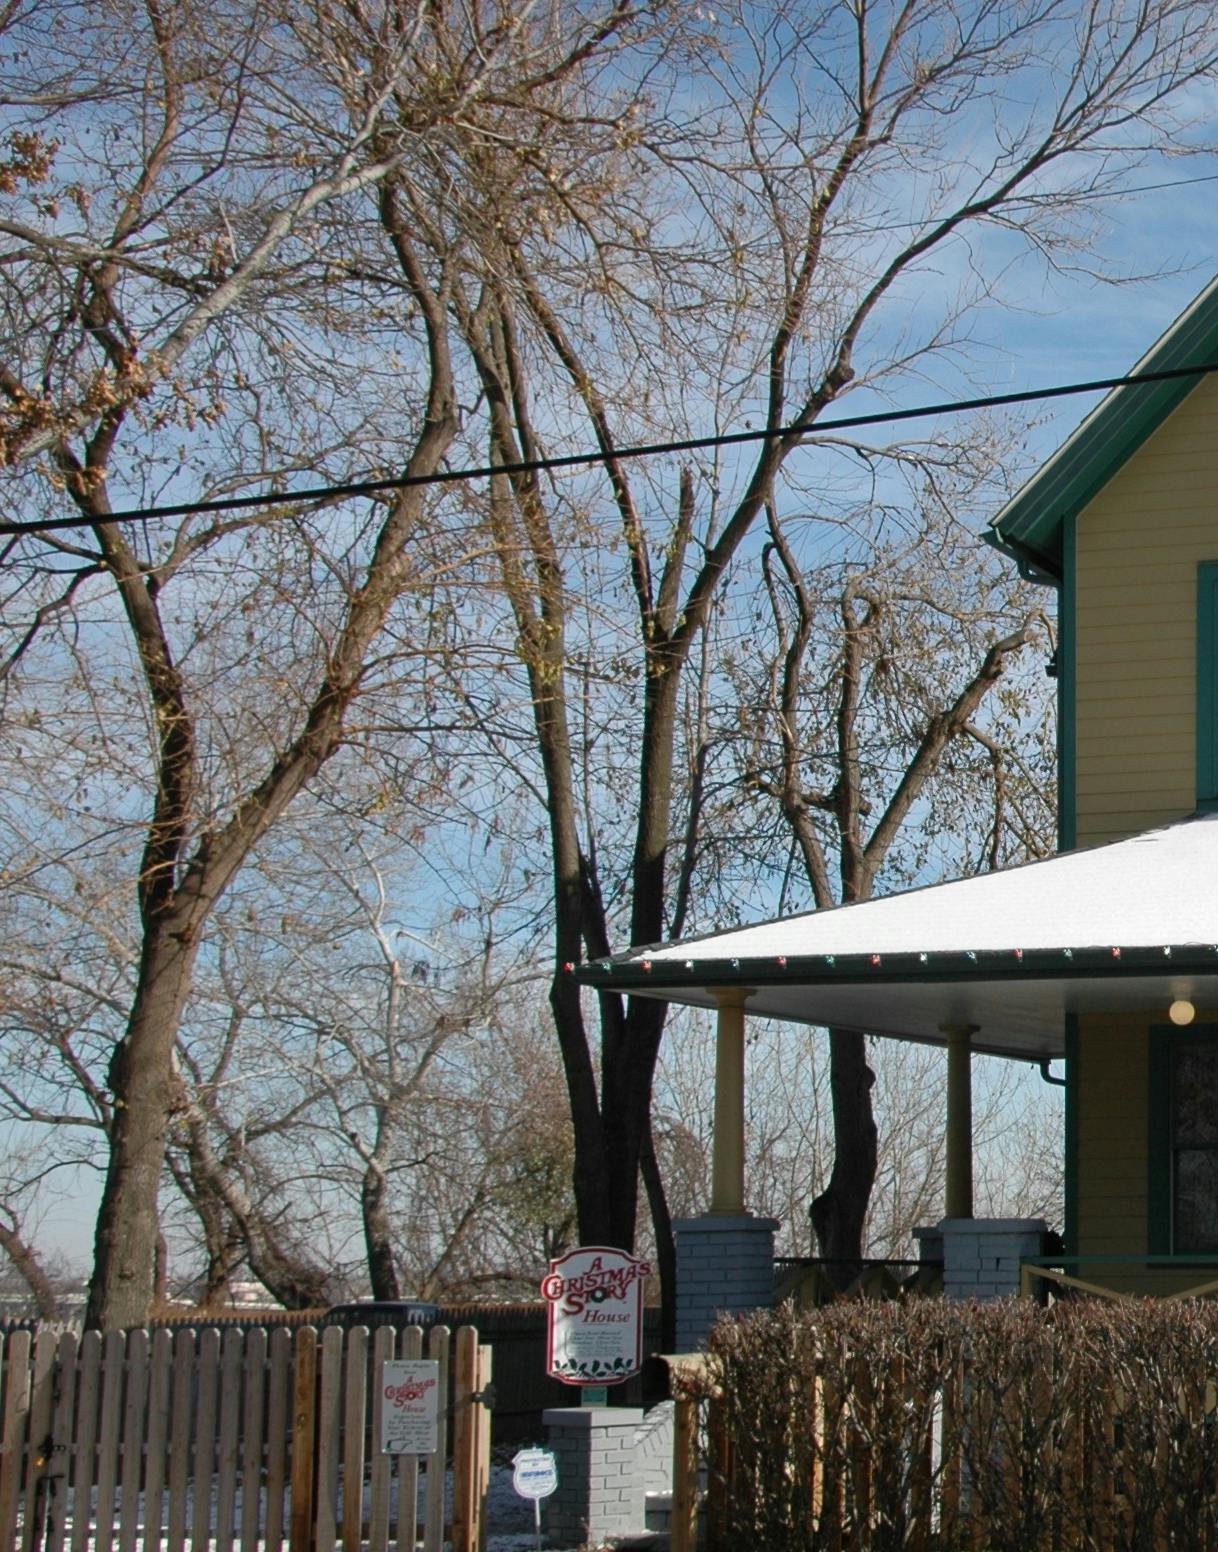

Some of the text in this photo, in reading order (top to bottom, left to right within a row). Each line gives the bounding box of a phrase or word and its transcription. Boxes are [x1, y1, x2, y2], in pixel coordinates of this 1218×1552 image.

[583, 1256, 603, 1276] A
[542, 1262, 651, 1300] CHRISTMAS
[562, 1279, 633, 1316] STORY
[583, 1309, 632, 1323] House
